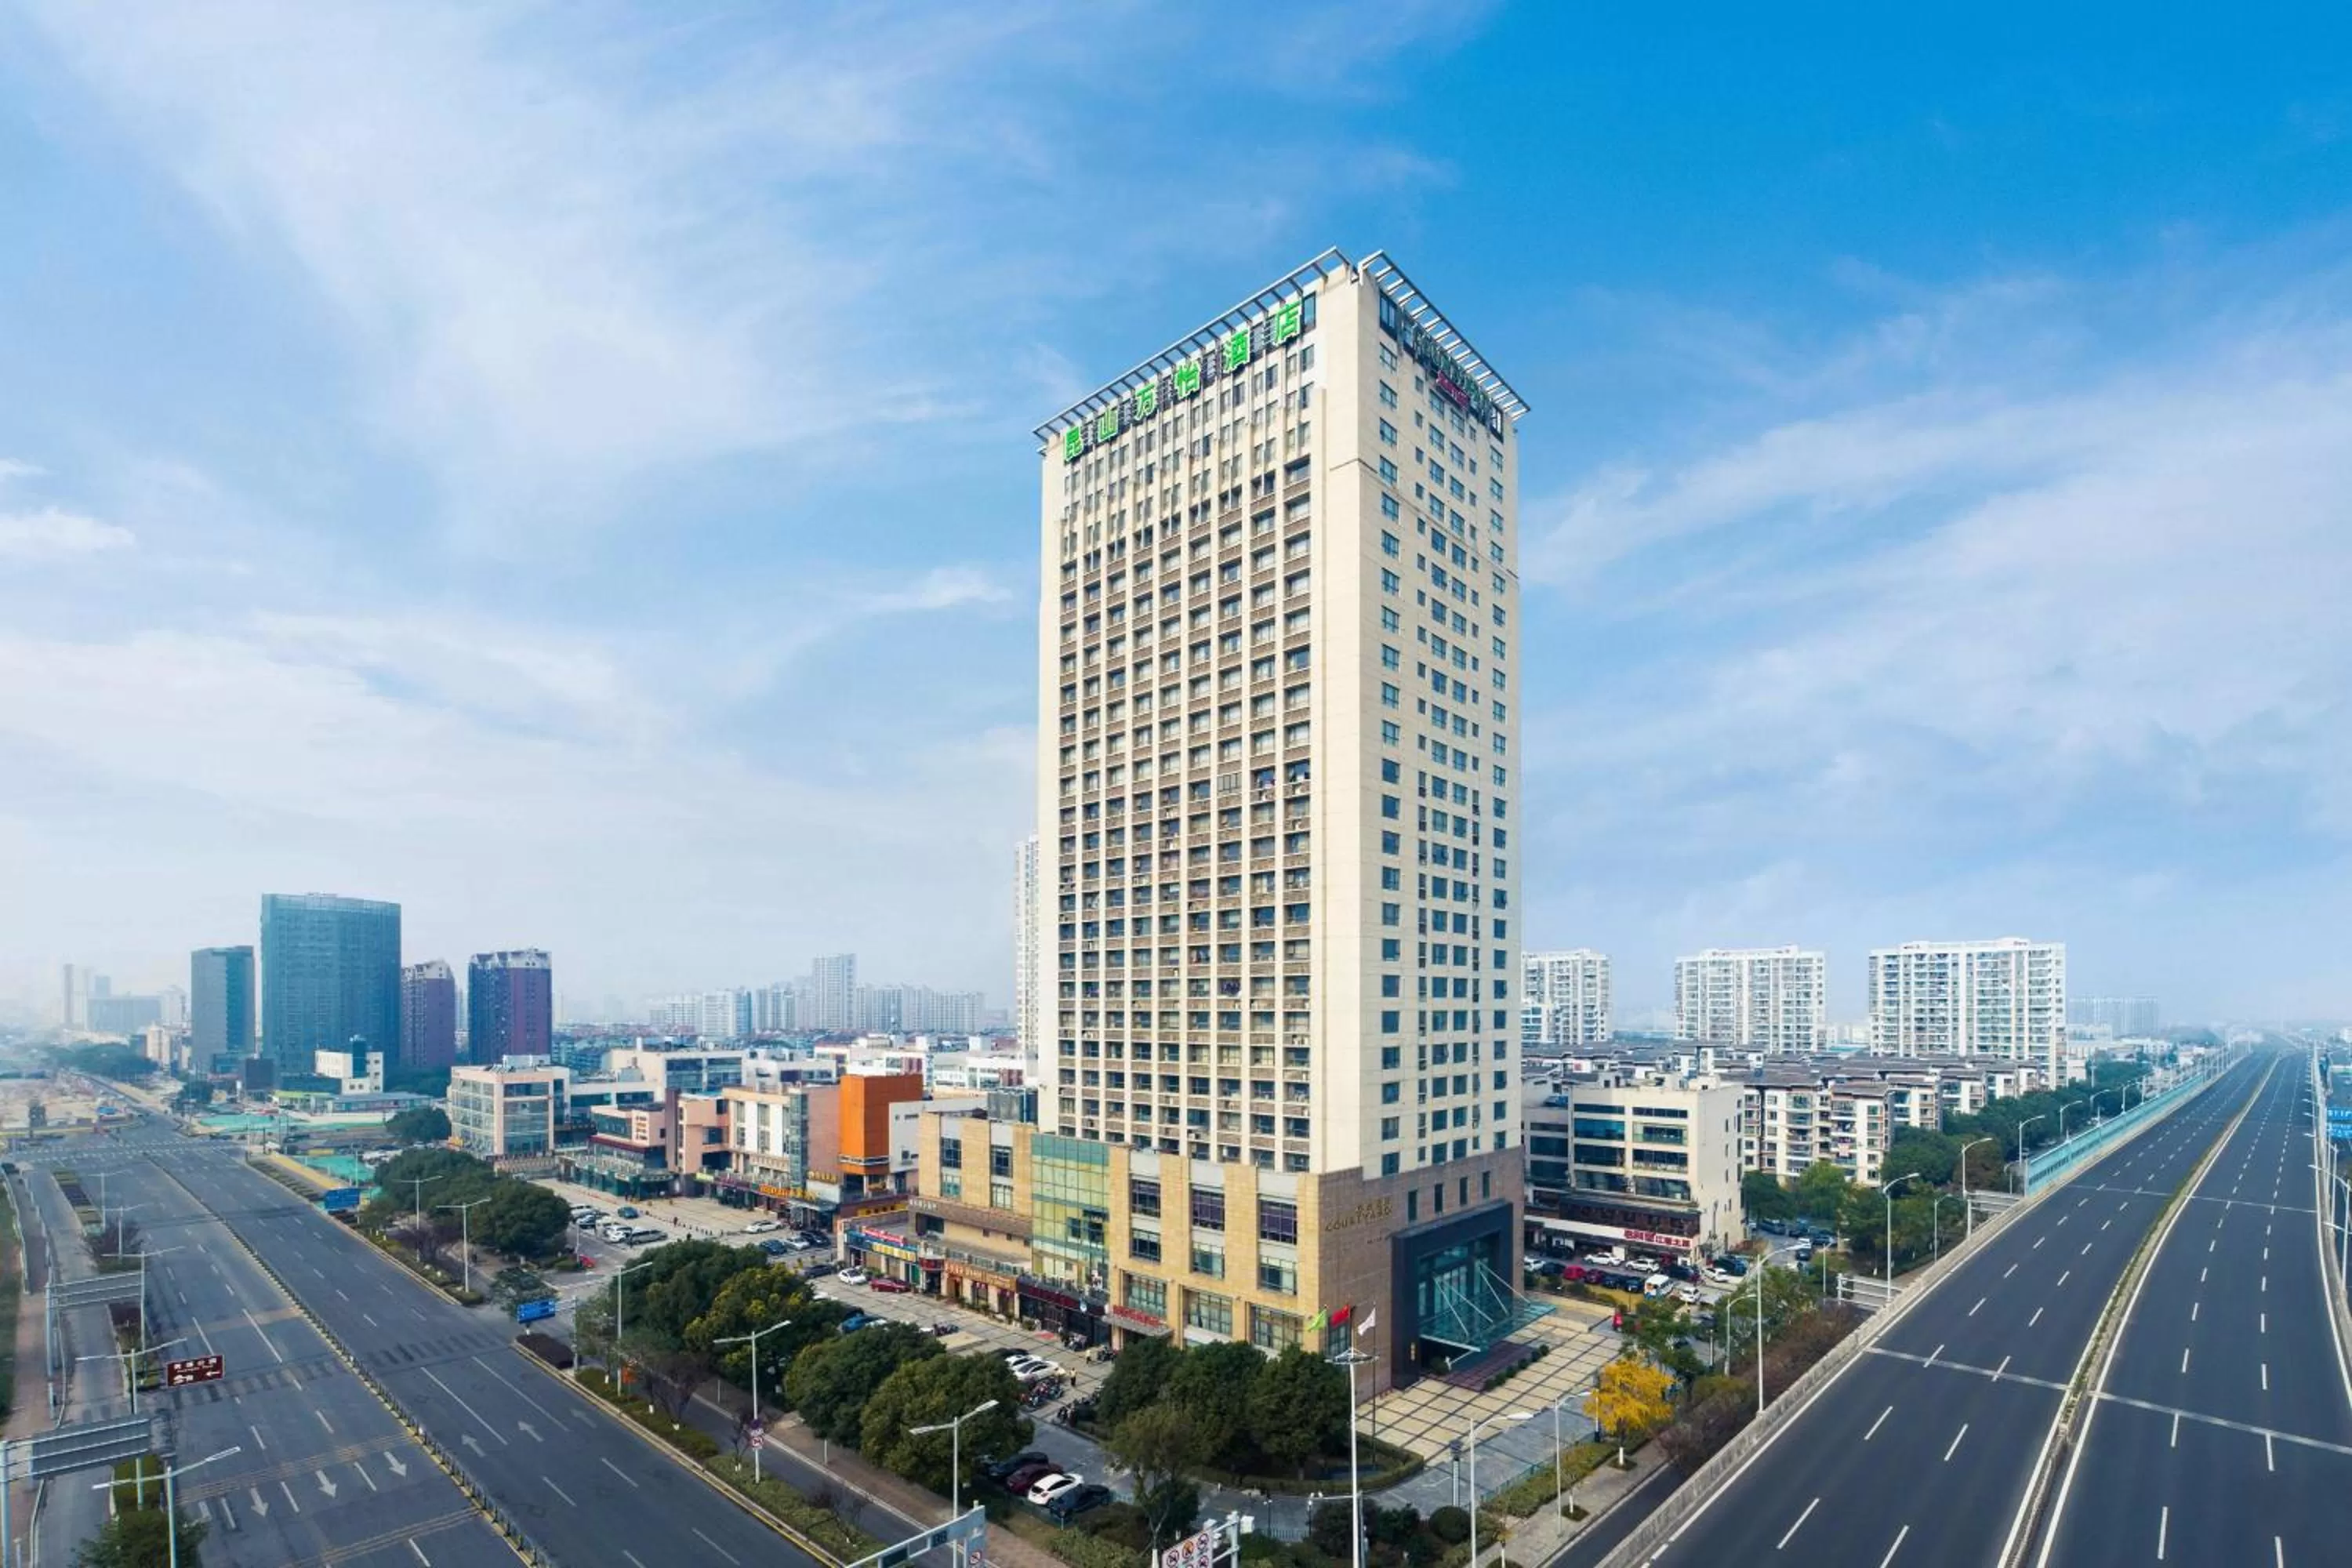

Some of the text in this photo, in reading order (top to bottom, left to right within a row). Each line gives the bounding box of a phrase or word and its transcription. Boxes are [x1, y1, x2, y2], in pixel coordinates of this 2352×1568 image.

[1064, 300, 1302, 464] 昆山万怡酒店
